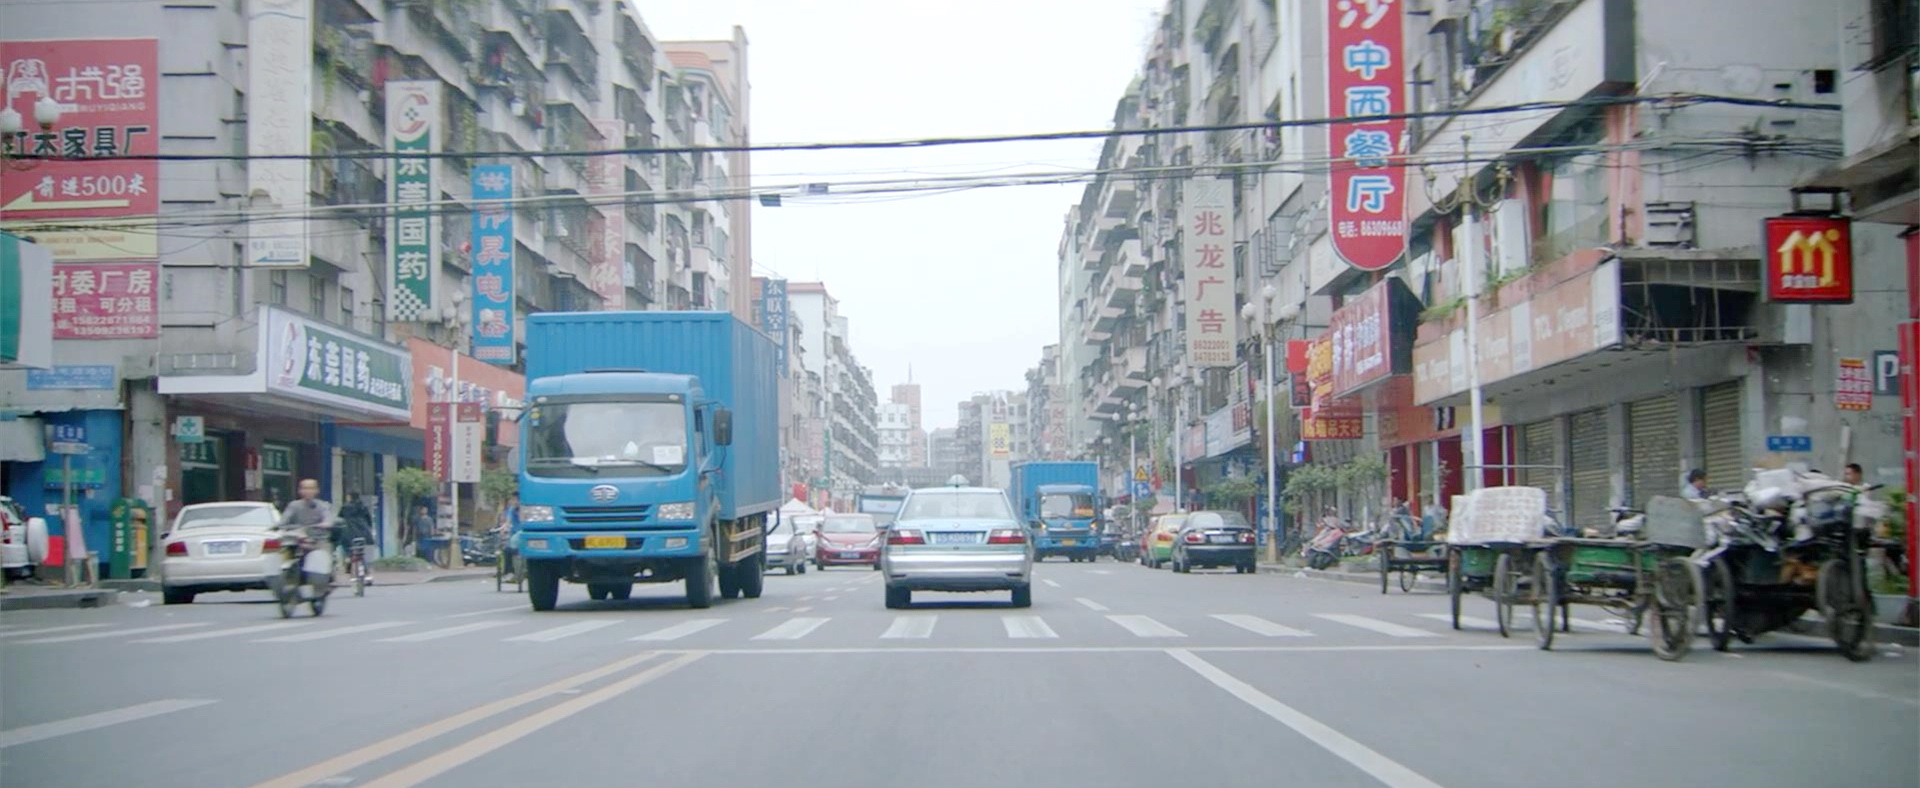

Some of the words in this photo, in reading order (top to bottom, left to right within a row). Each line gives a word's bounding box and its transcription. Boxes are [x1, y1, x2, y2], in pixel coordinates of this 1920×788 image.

[34, 173, 148, 198] 前进500米
[397, 147, 429, 281] 东莞国药
[1194, 211, 1226, 334] 兆龙广告
[307, 336, 370, 393] 东莞国药
[1878, 354, 1899, 391] P
